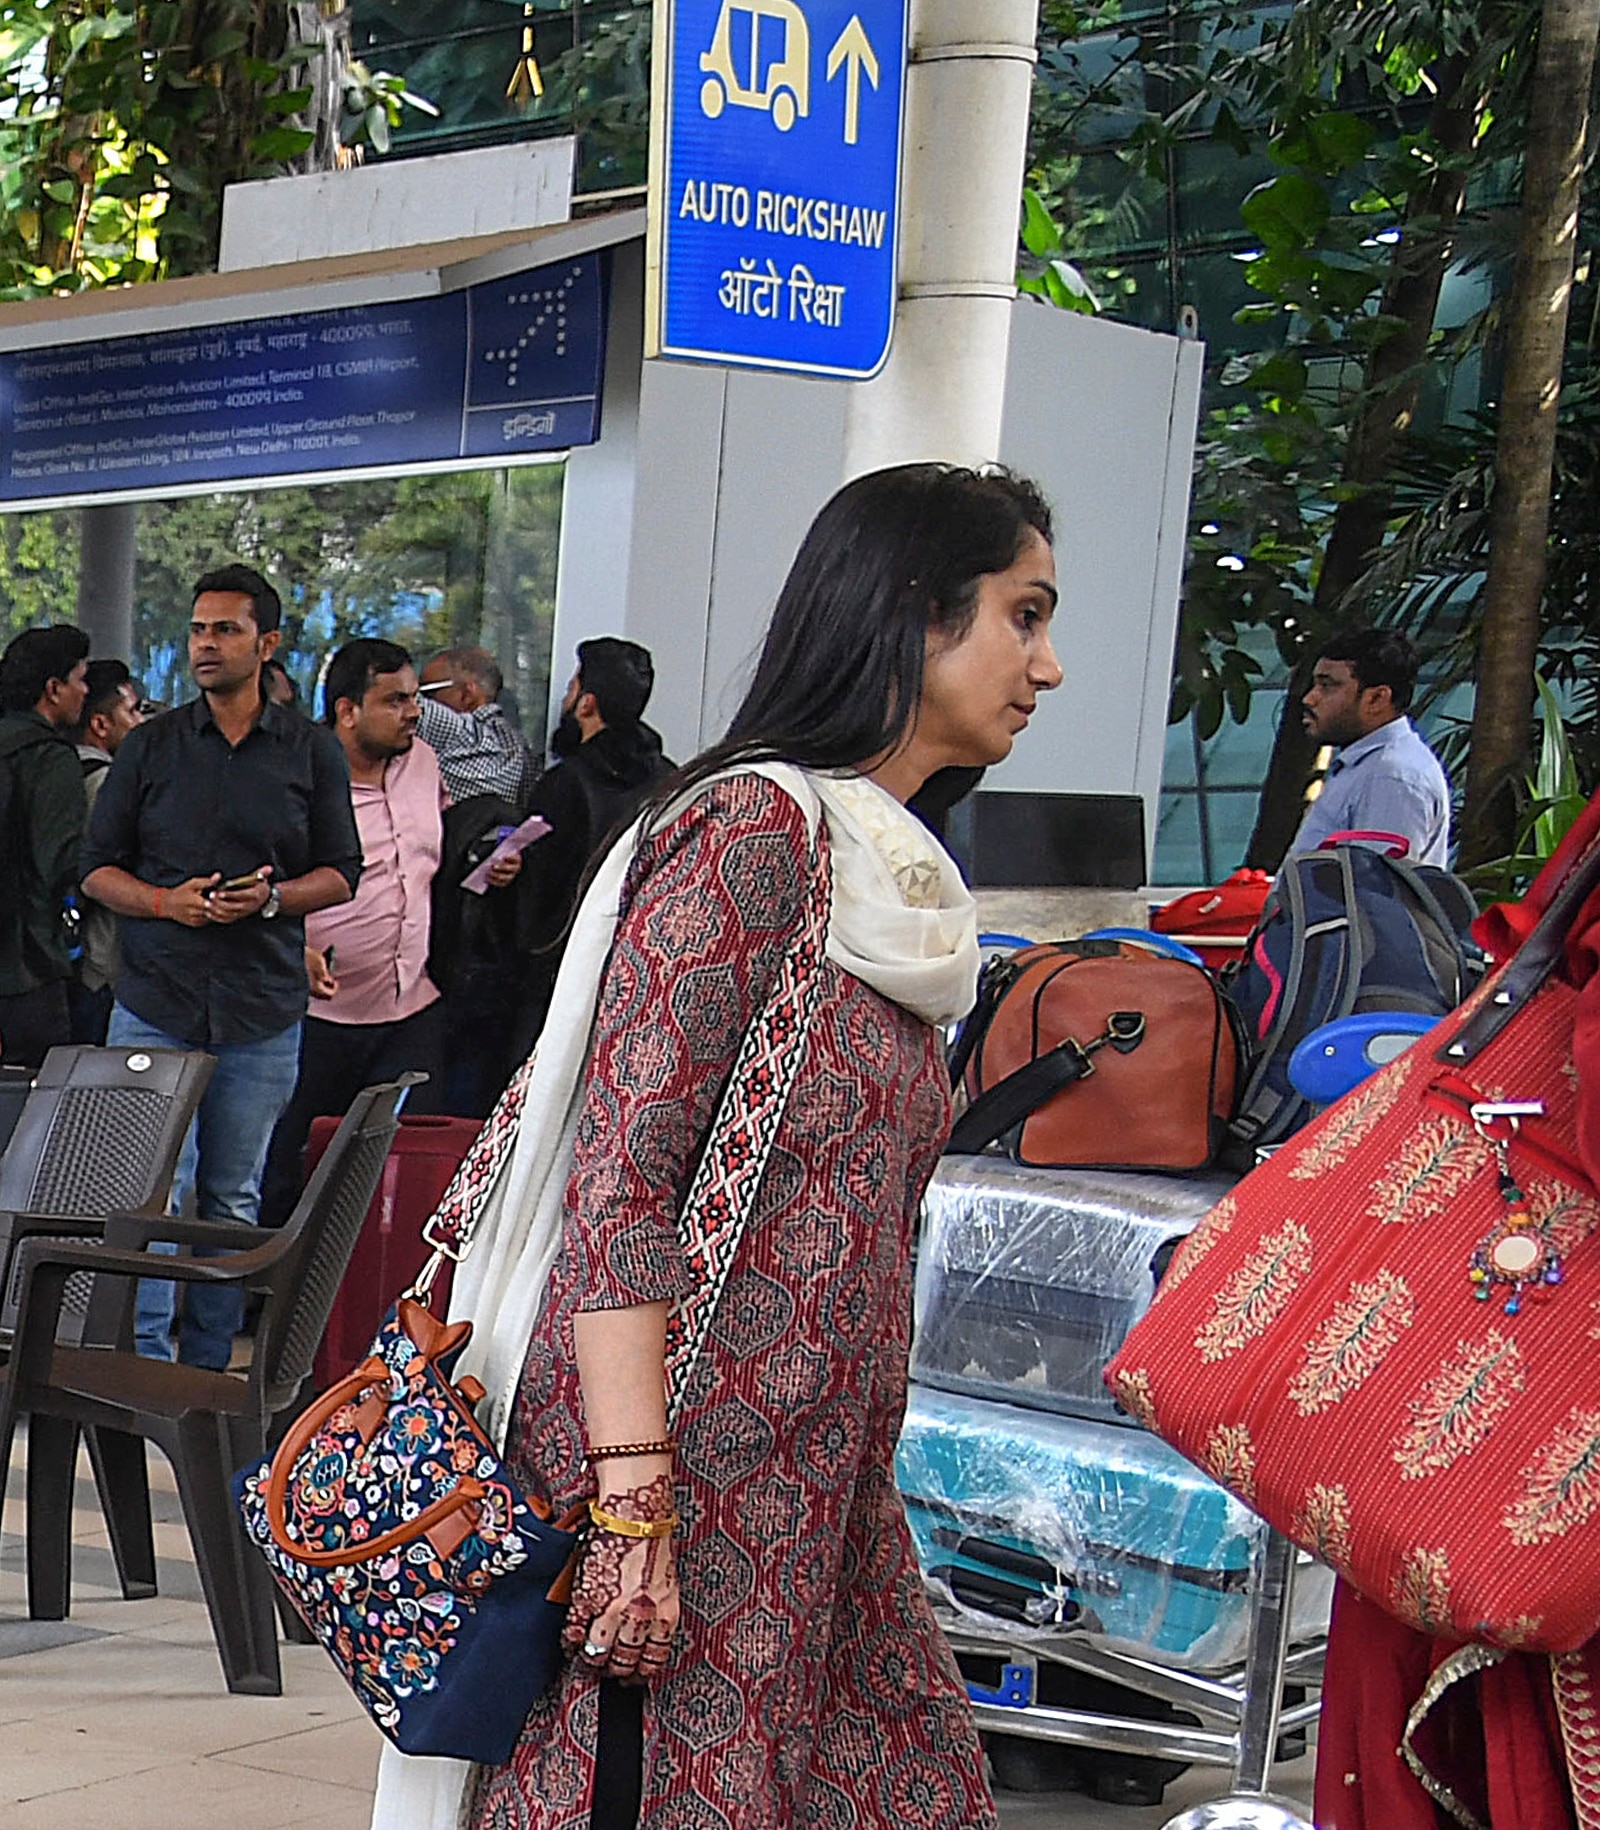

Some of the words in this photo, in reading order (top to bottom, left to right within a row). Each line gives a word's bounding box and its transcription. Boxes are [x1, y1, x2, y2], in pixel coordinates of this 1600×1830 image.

[679, 179, 749, 228] AUTO
[755, 190, 887, 249] RICKSHAW
[718, 256, 782, 320] ऑटो
[788, 264, 846, 327] रिक्षा
